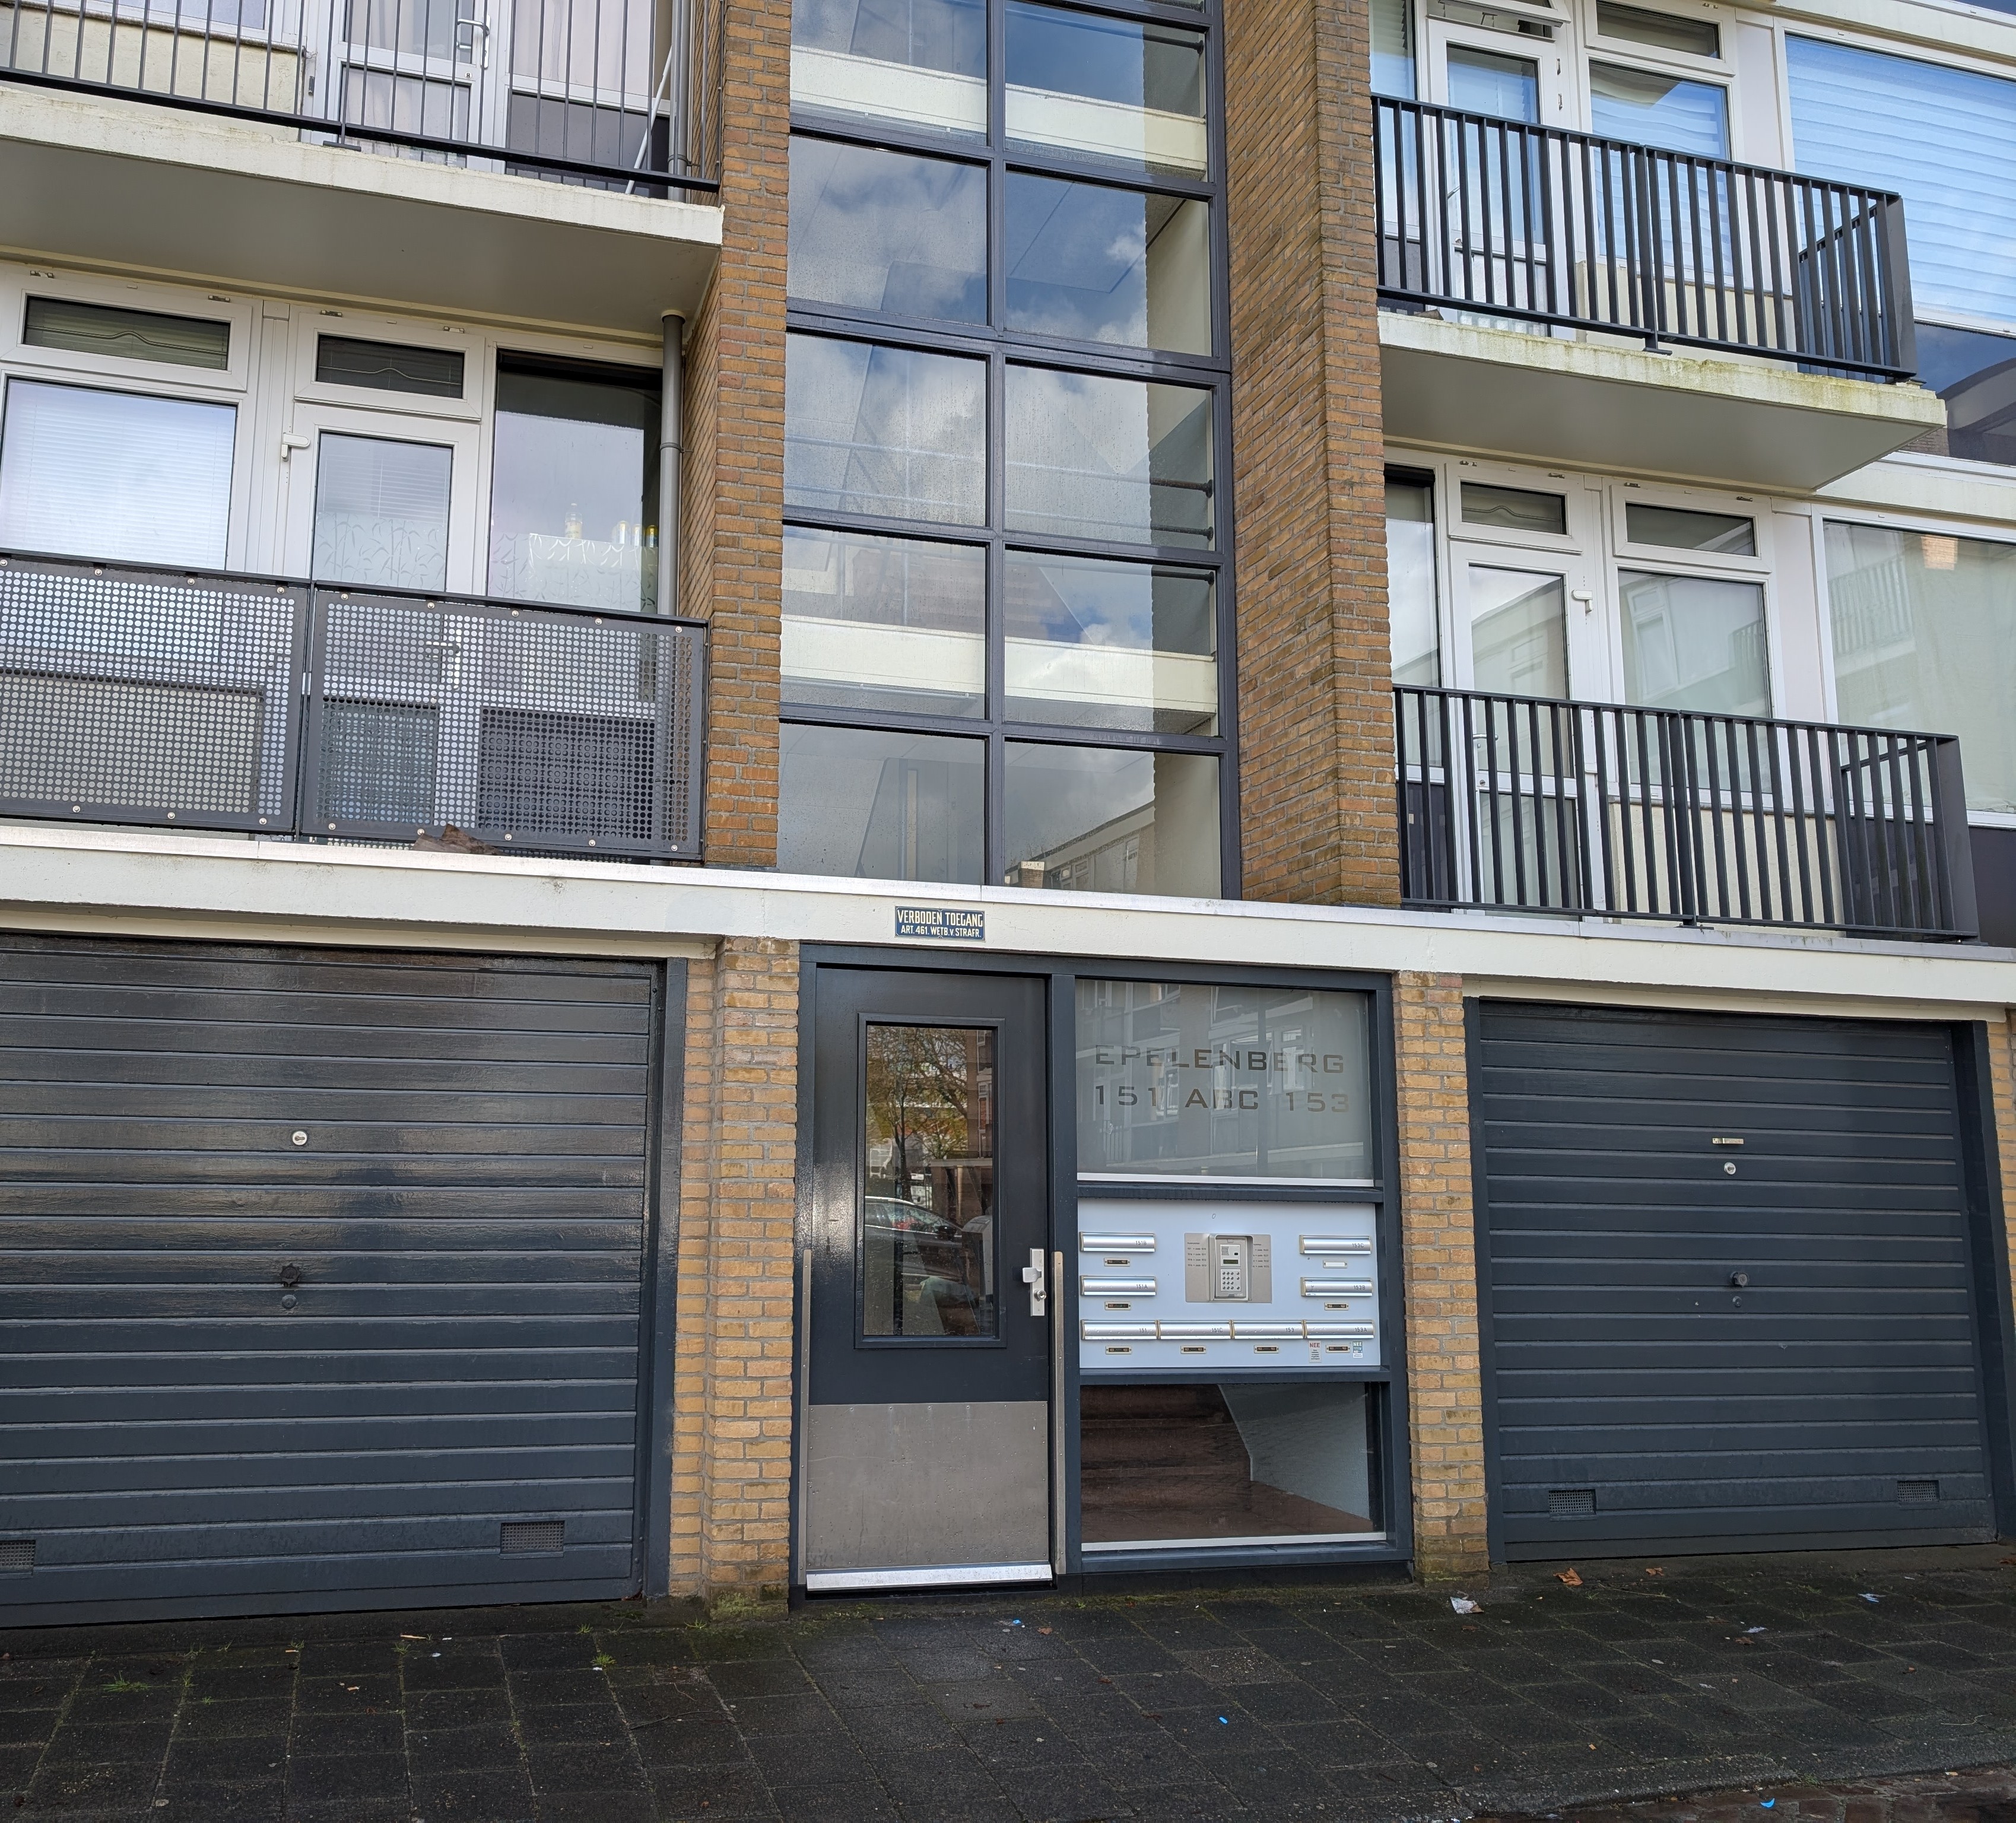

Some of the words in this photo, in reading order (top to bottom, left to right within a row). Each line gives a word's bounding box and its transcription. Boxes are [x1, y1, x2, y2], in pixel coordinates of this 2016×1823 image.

[897, 910, 942, 925] VERBODEN
[945, 912, 983, 927] TOEGANG
[1096, 1044, 1344, 1073] EPELENBERG
[1096, 1085, 1157, 1107] 151
[1185, 1088, 1259, 1110] ABC
[1285, 1092, 1350, 1113] 153
